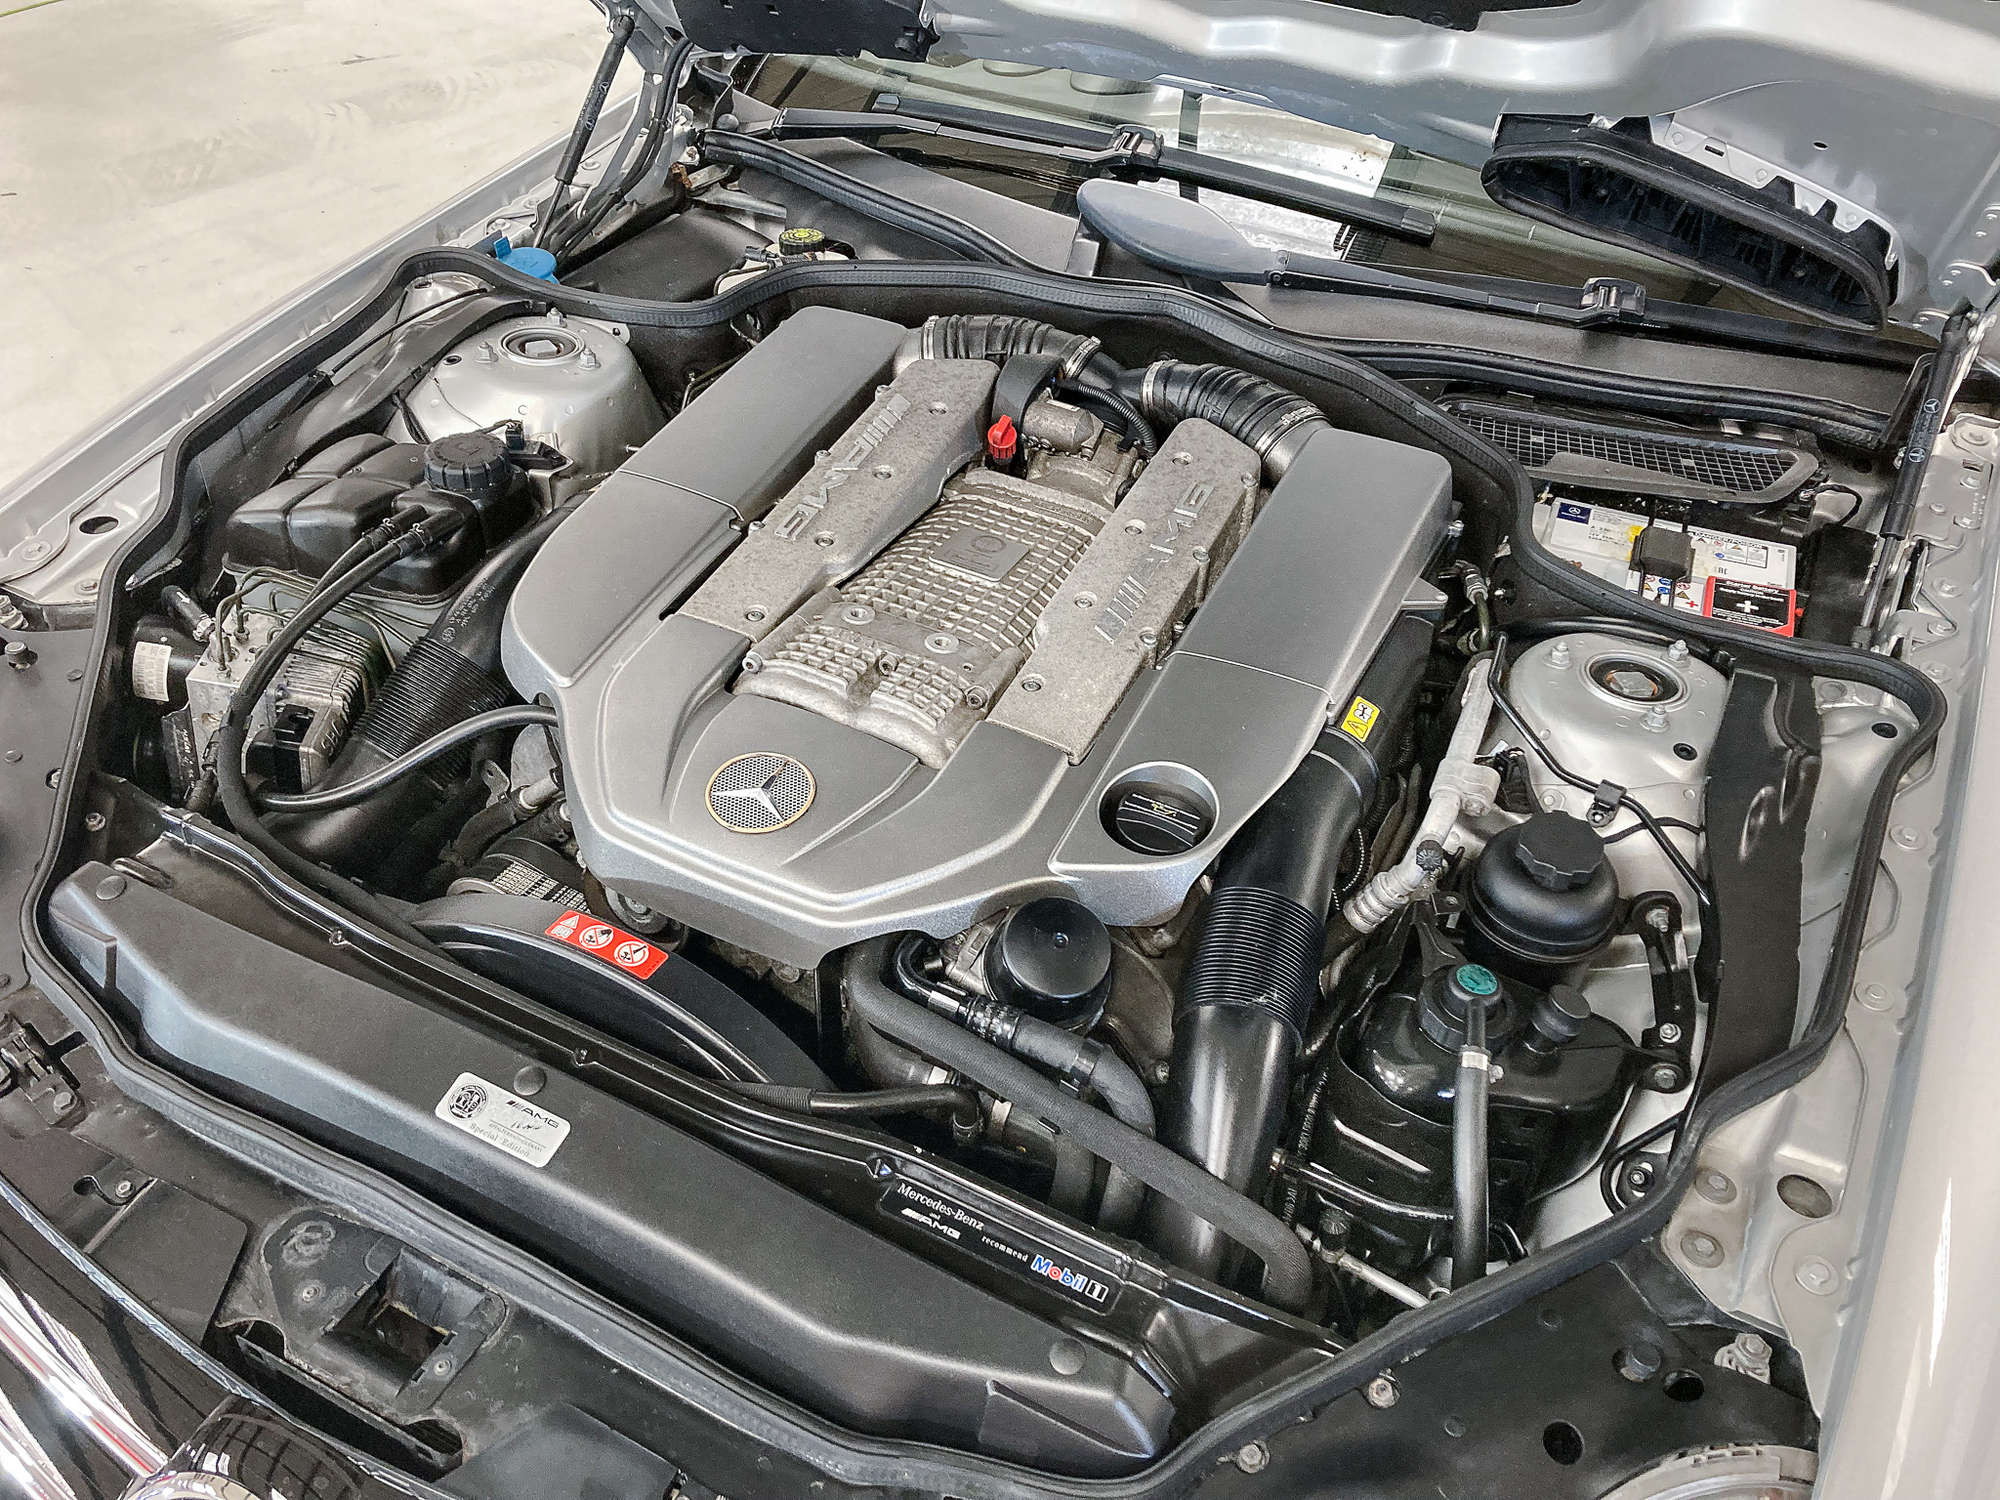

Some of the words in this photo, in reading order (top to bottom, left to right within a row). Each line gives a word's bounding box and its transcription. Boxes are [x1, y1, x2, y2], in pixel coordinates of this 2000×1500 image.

[520, 1106, 560, 1129] AMG
[469, 1122, 498, 1142] Special
[501, 1136, 530, 1157] Edition
[897, 1183, 984, 1231] Mercedes-Benz
[916, 1215, 961, 1240] AMG
[981, 1235, 1029, 1263] recommend
[1031, 1254, 1088, 1291] Mobil
